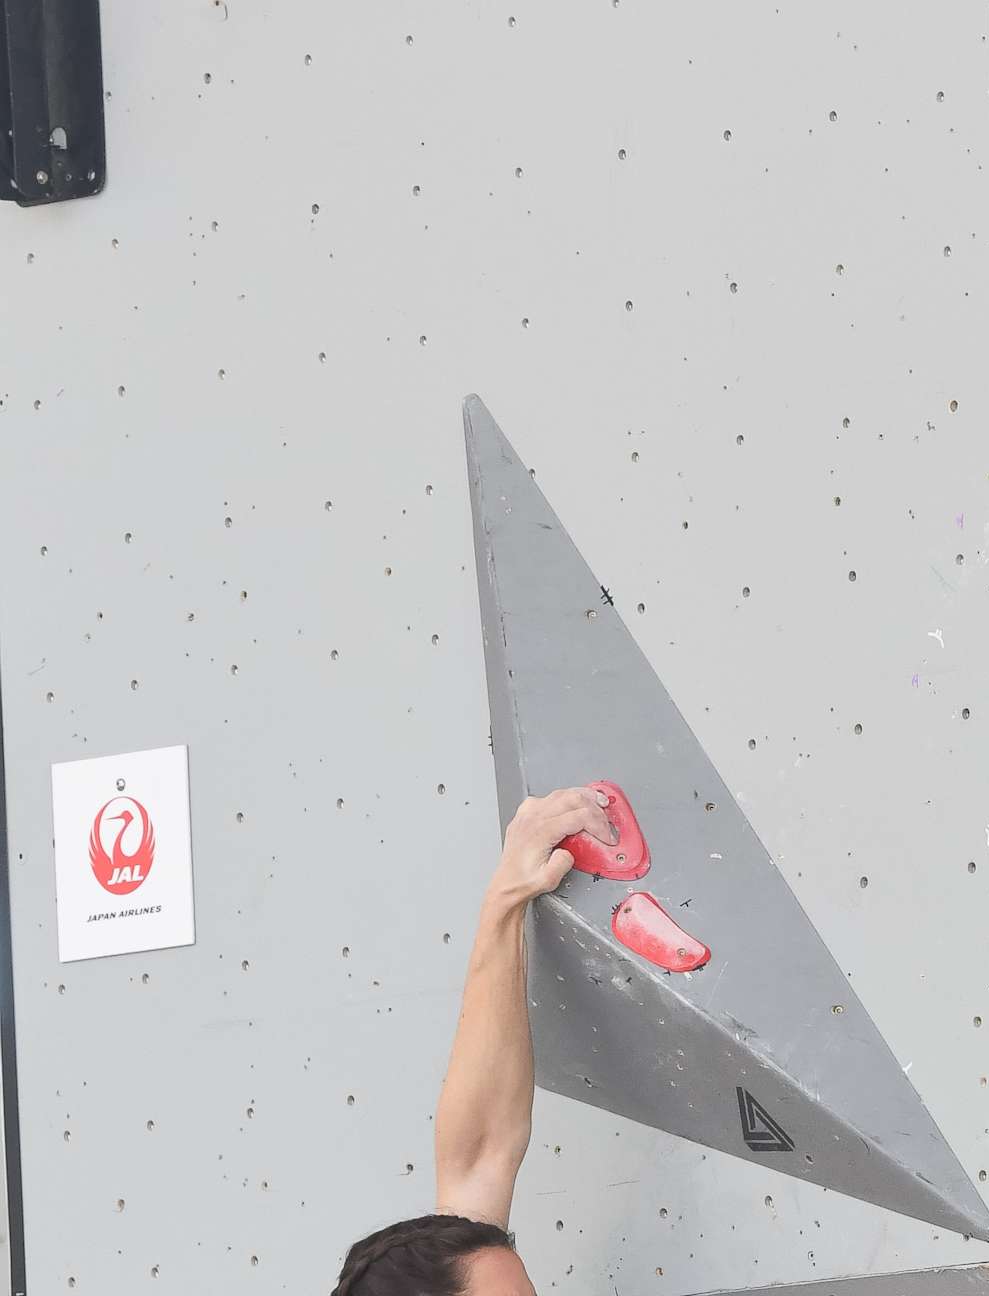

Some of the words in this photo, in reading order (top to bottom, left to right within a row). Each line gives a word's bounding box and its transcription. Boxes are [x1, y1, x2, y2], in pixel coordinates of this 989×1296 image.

[107, 864, 144, 885] JAL
[87, 912, 116, 923] JAPAN
[118, 905, 162, 918] AIRLINES
